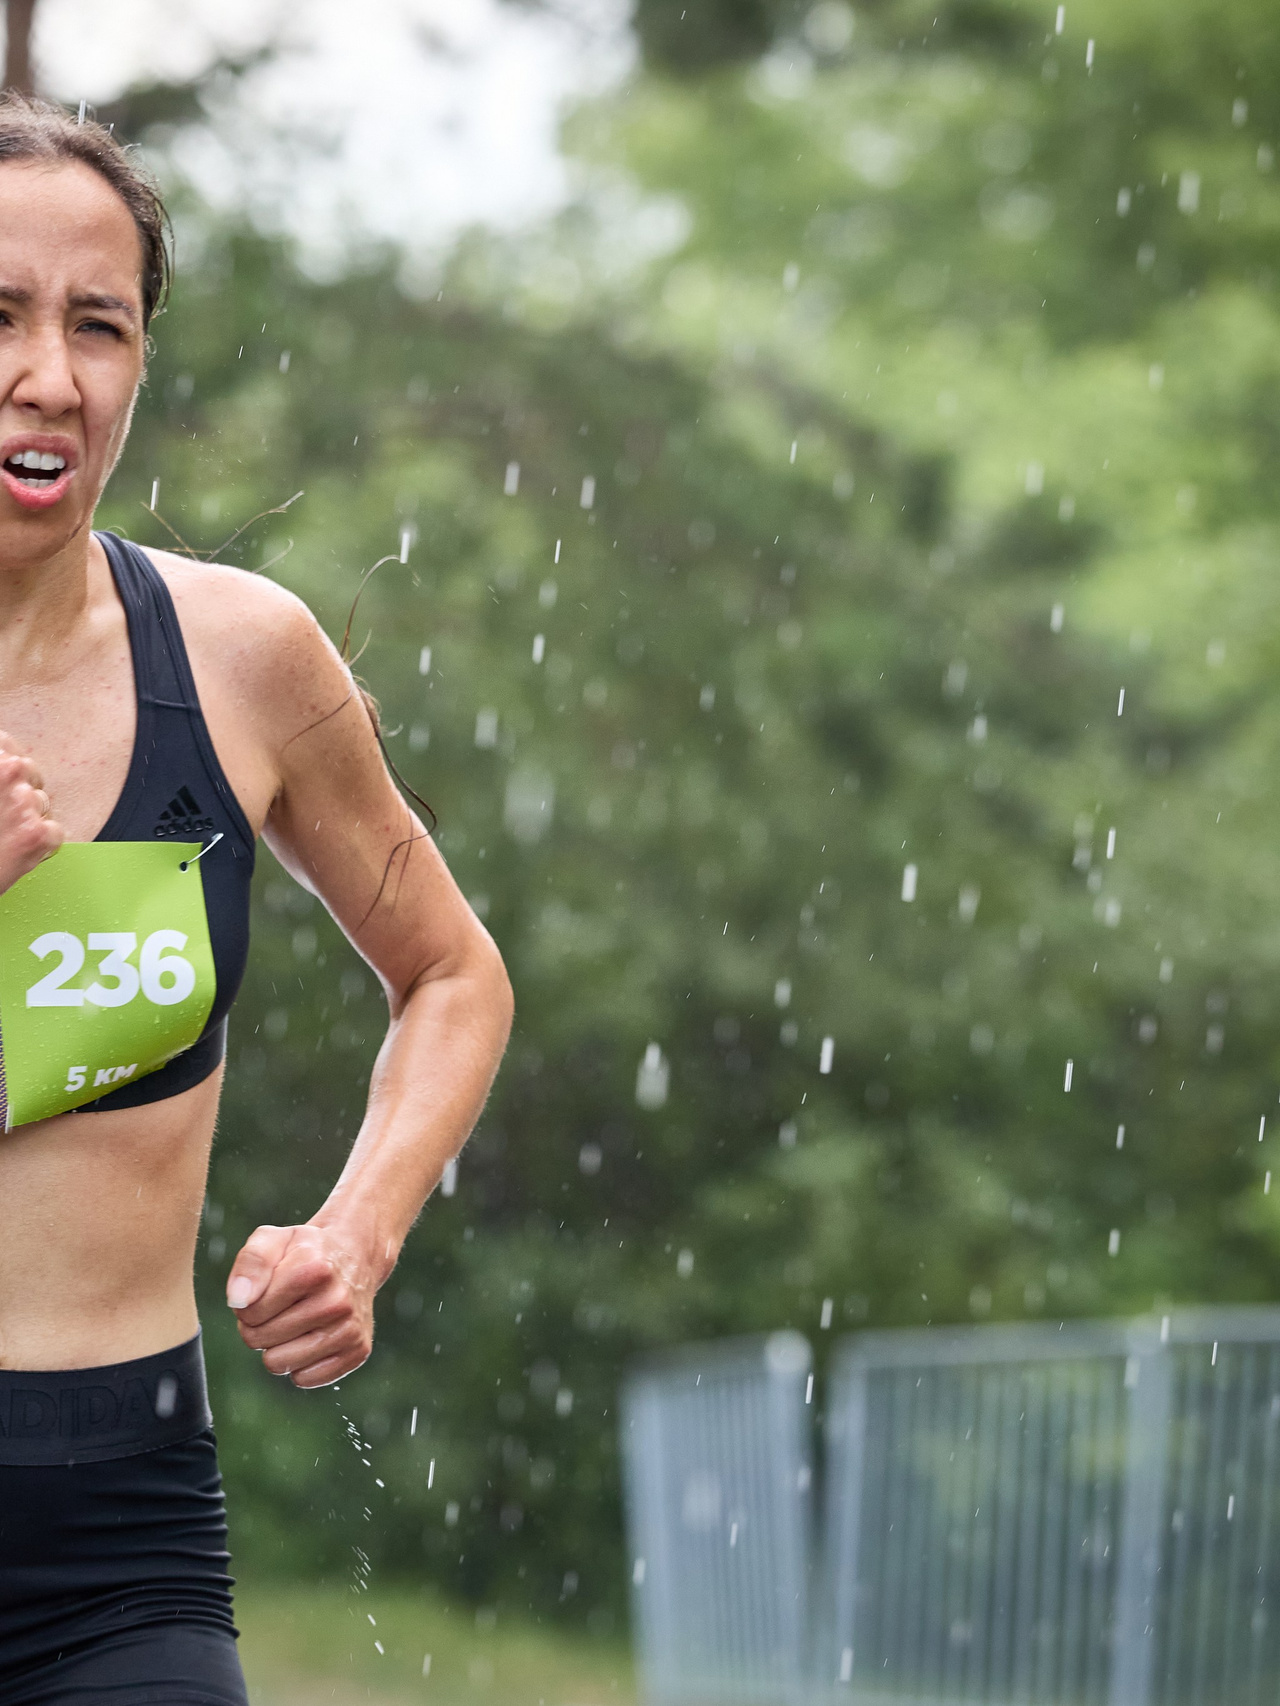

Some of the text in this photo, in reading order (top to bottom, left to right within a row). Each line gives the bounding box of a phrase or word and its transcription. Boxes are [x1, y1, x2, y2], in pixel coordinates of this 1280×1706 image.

[154, 817, 214, 837] adidas
[26, 929, 196, 1008] 236
[63, 1065, 88, 1092] 5
